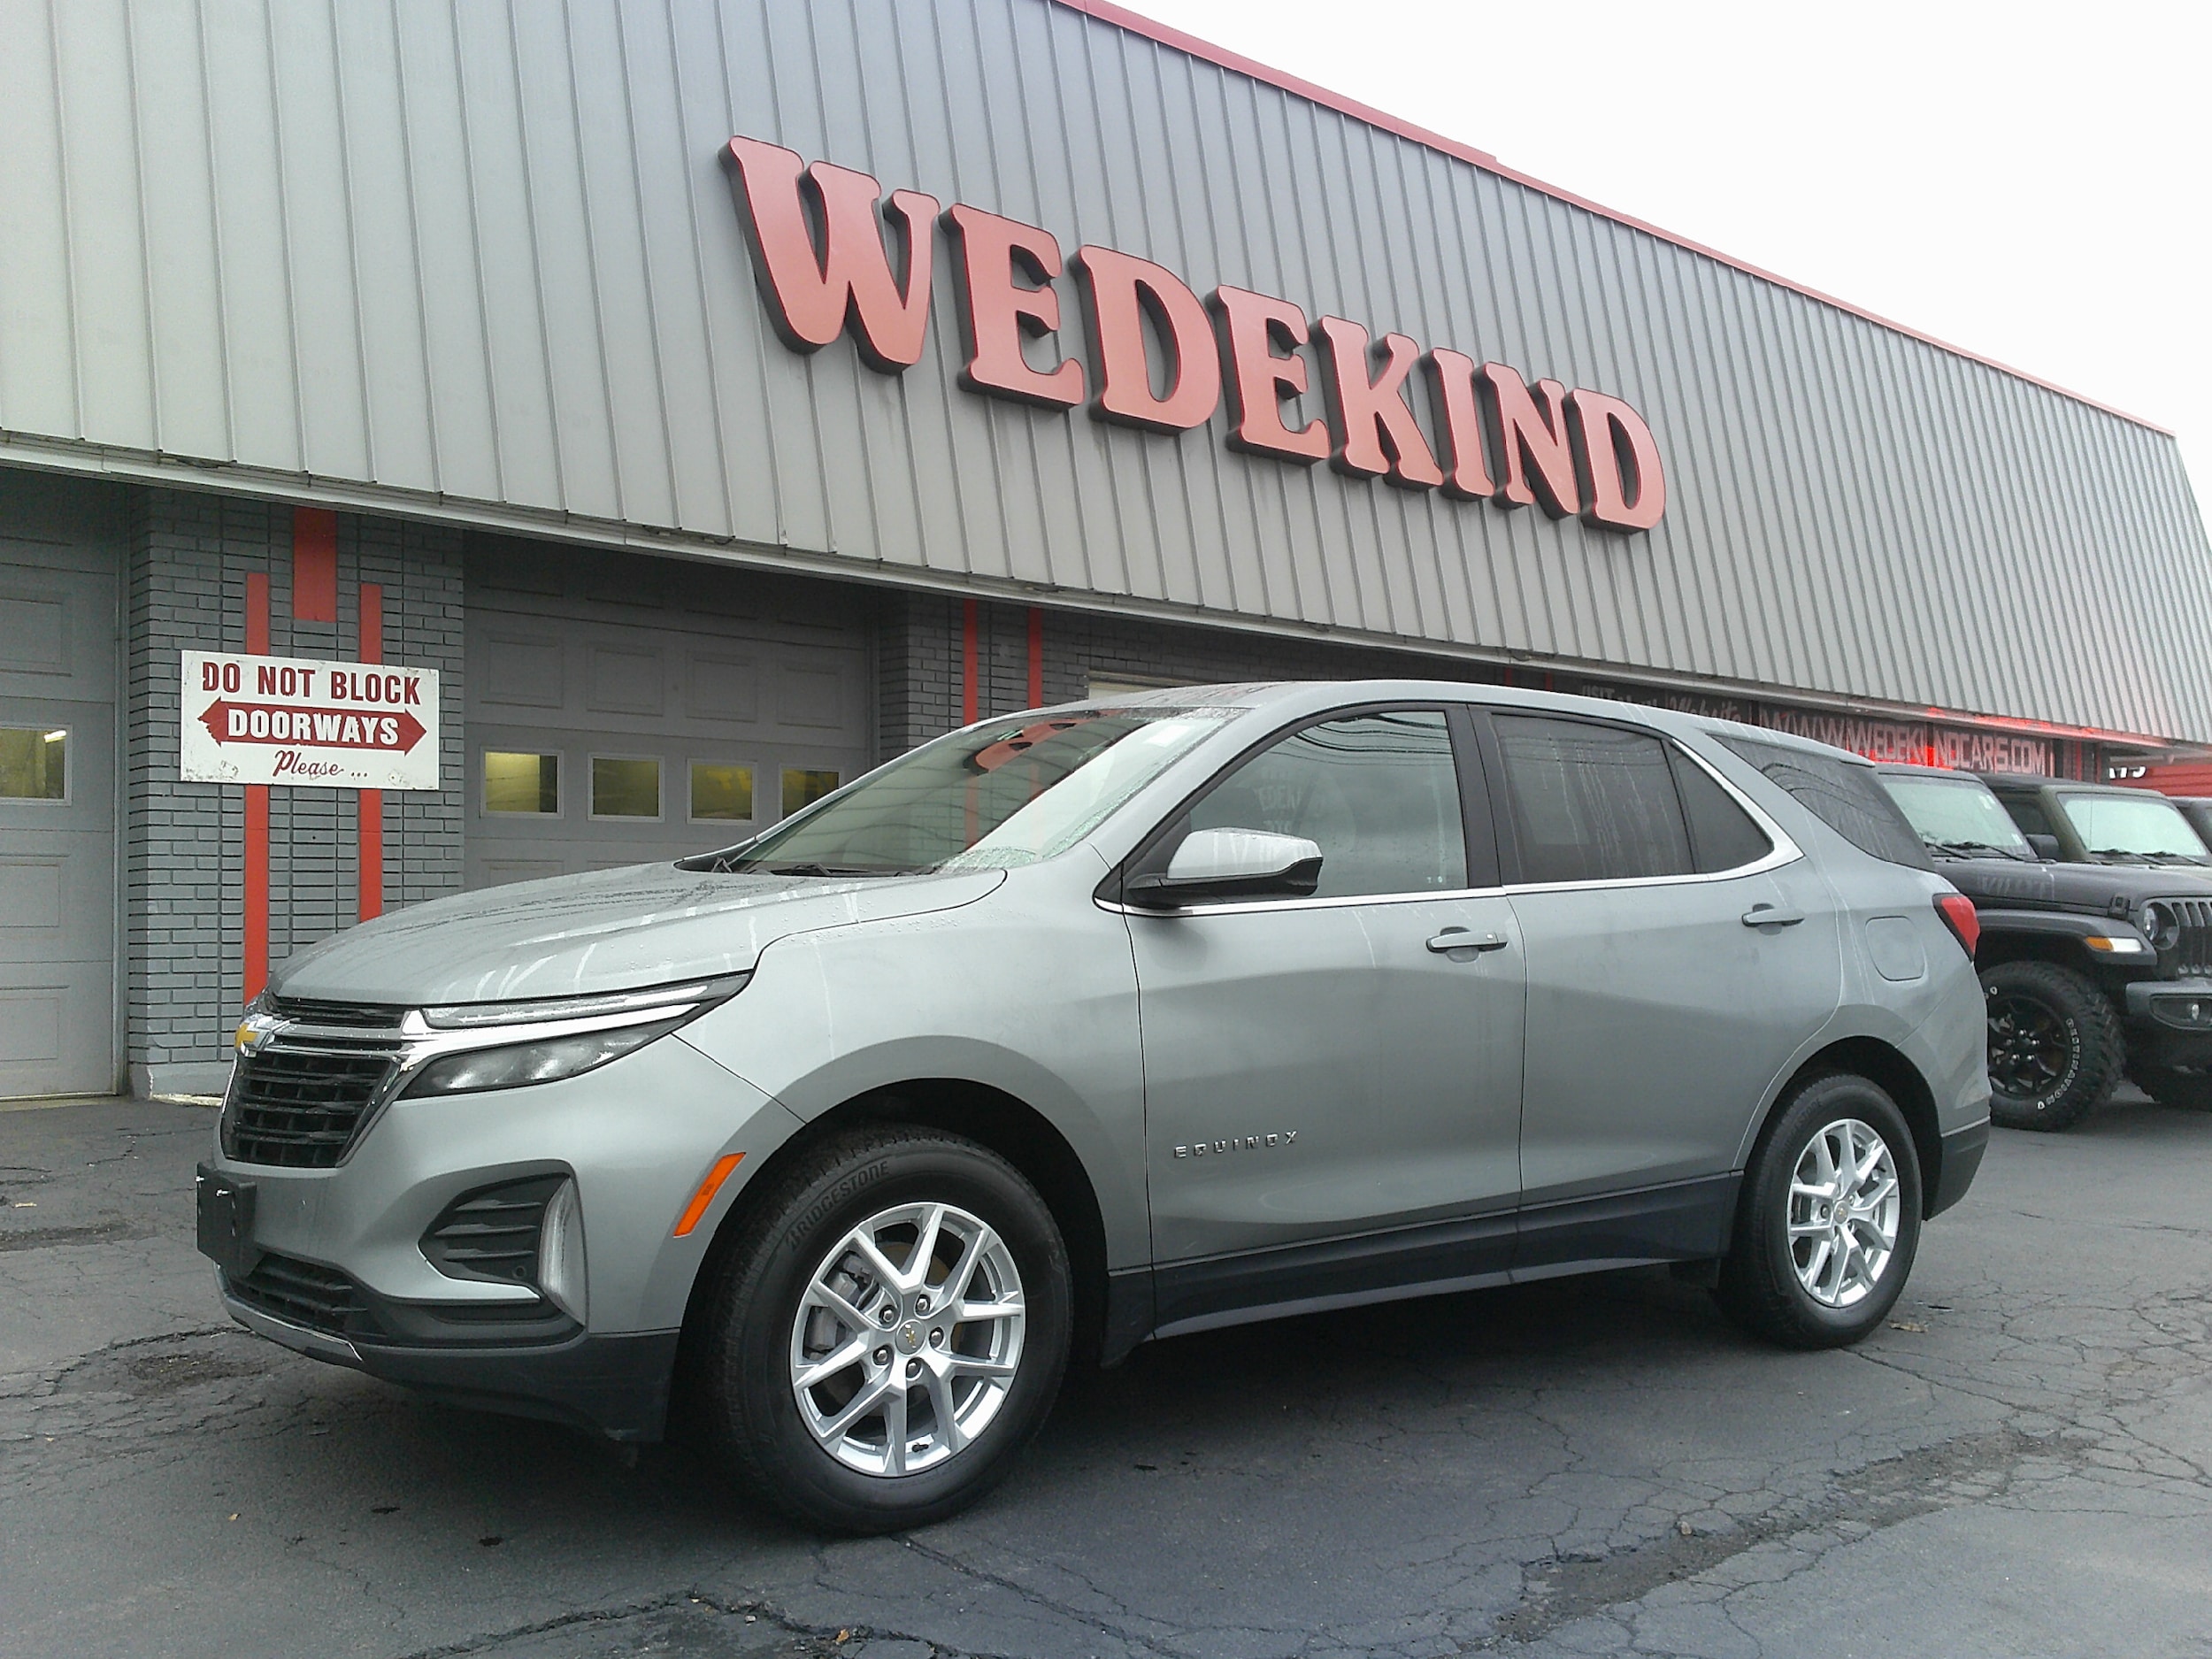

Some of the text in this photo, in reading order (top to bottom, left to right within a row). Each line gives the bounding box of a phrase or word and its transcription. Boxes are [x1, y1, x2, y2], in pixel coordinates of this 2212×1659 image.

[722, 134, 1666, 534] WEDEKIND
[202, 661, 421, 705] DO NOT BLOCK
[227, 709, 399, 745] DOORWAYS
[1763, 710, 2046, 775] WWWWEDEKINDCARS.COM
[273, 750, 345, 778] Please
[1174, 1131, 1297, 1158] EQUINOX
